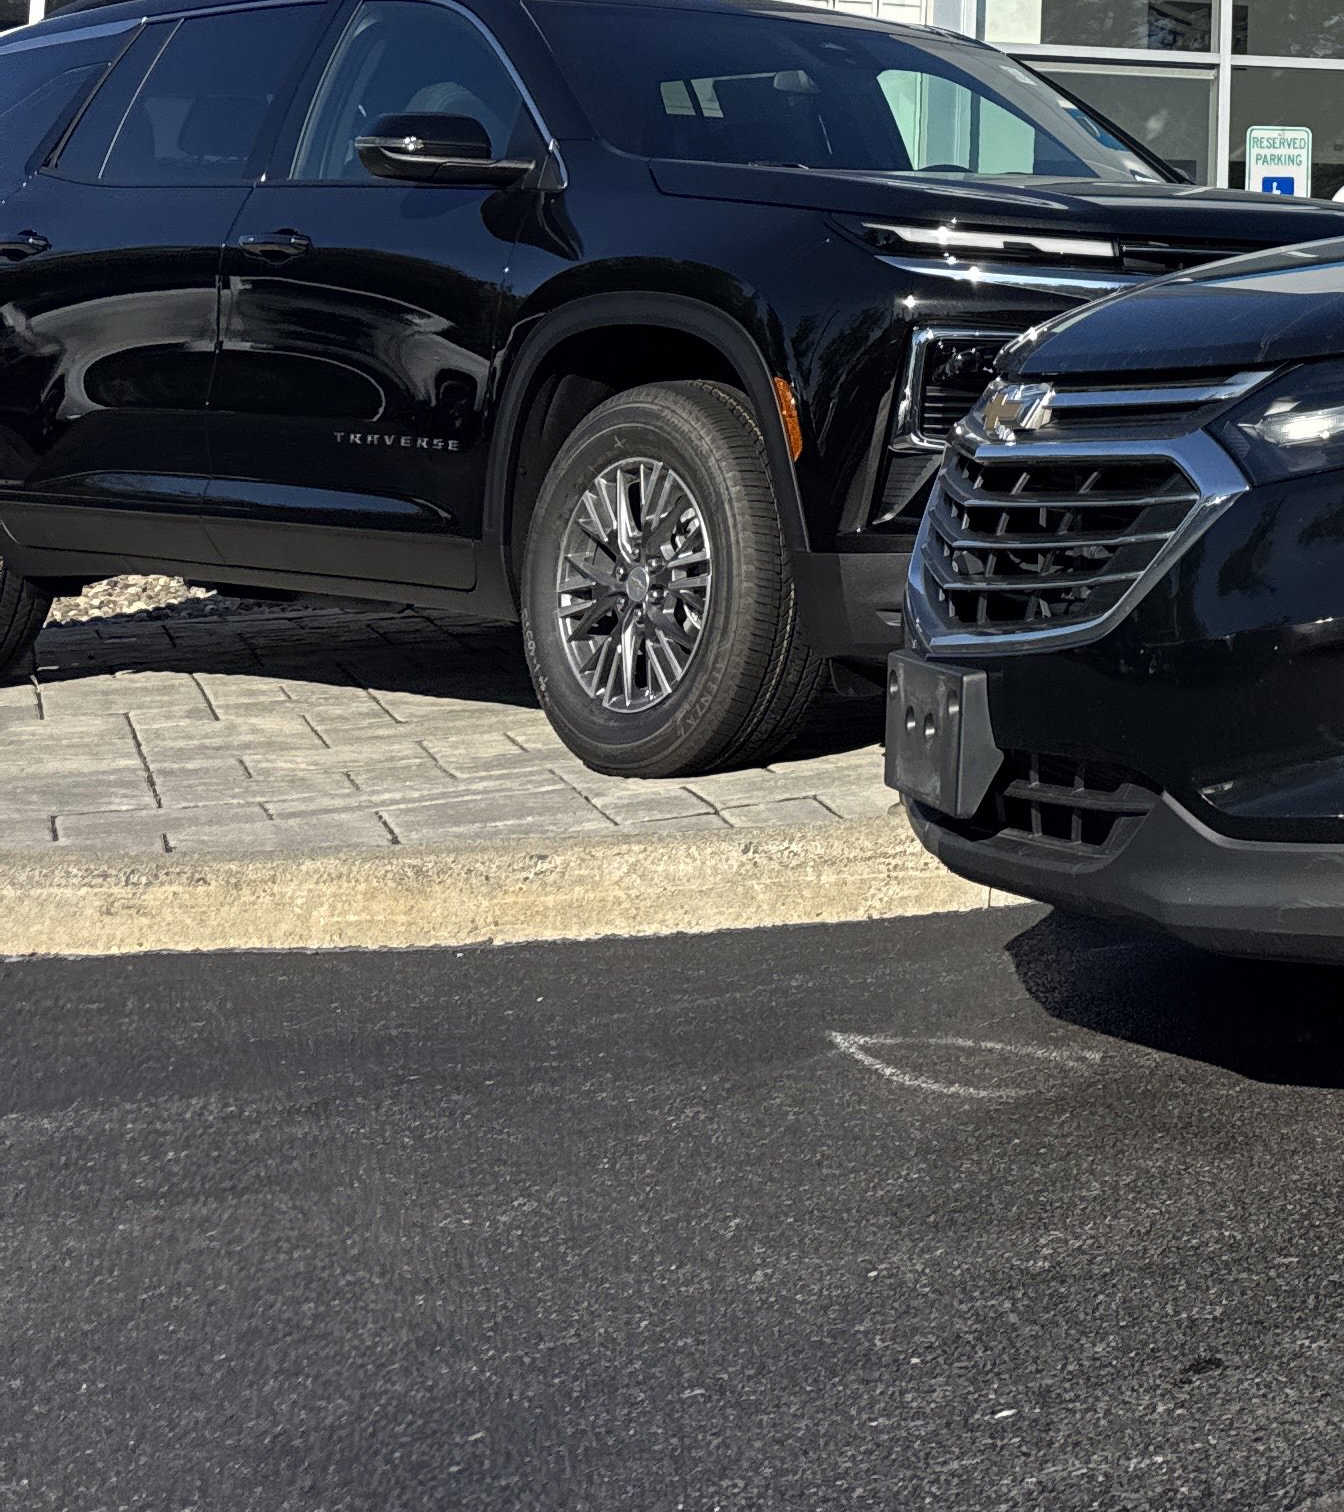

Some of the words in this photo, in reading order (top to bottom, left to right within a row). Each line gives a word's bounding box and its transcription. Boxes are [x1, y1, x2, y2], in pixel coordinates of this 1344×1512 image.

[1252, 137, 1306, 150] RESERVED
[1255, 153, 1303, 166] PARKING
[333, 431, 460, 451] TRAVERSE
